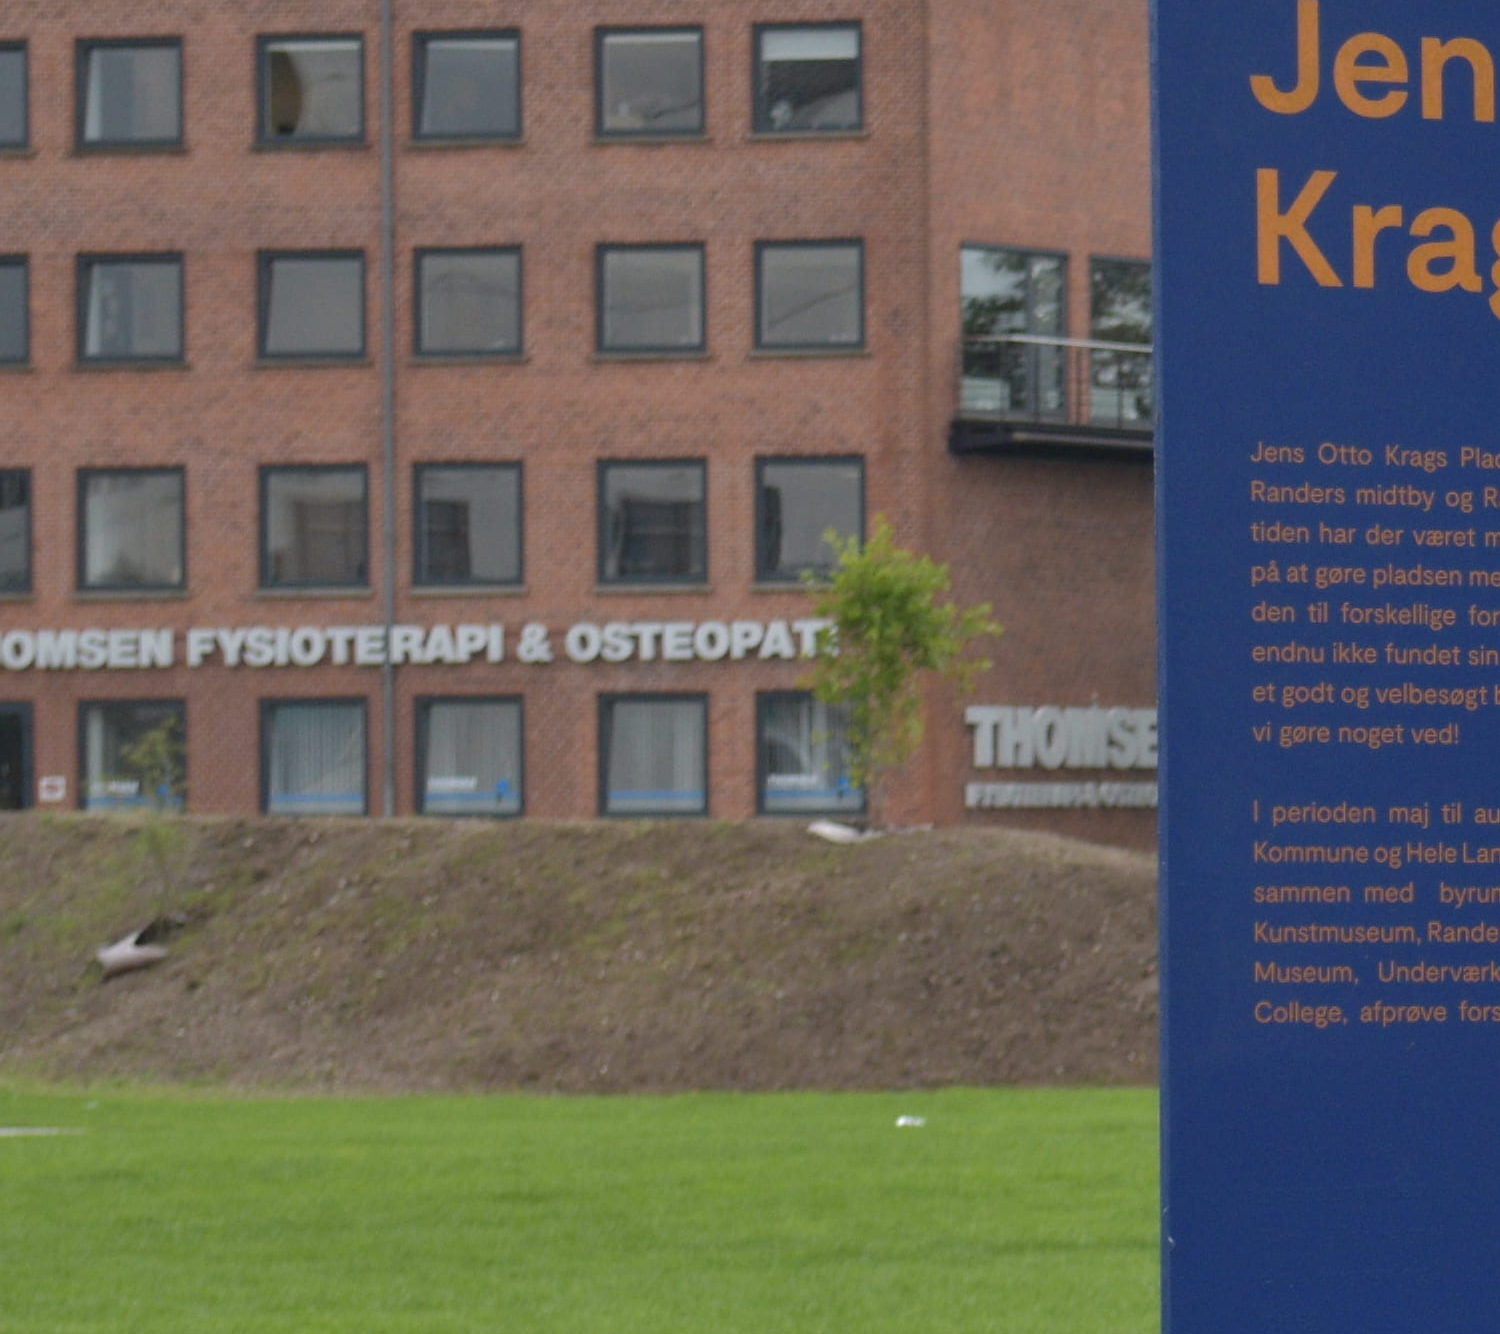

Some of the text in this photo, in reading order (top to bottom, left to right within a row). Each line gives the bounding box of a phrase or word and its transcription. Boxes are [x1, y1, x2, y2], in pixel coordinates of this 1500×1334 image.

[1251, 442, 1306, 464] Jens
[1318, 442, 1373, 465] Otto
[1385, 445, 1448, 473] Krags
[1251, 479, 1346, 504] Randers
[1356, 485, 1435, 511] midtby
[1445, 491, 1474, 513] og
[1251, 522, 1311, 543] tiden
[1319, 523, 1356, 544] har
[1366, 524, 1404, 545] der
[1413, 528, 1476, 547] været
[1251, 560, 1281, 586] på
[1286, 564, 1309, 583] at
[1315, 566, 1367, 589] gøre
[1373, 564, 1464, 589] pladsen
[1251, 601, 1296, 622] den
[1308, 602, 1330, 623] til
[1341, 602, 1457, 631] forskellige
[186, 622, 506, 668] FYSIOTERAPI
[517, 622, 553, 663] &
[1252, 642, 1326, 664] endnu
[1333, 642, 1378, 664] ikke
[1386, 642, 1461, 665] fundet
[1469, 647, 1500, 666] sin
[1253, 723, 1460, 749] vi gøre noget ved!
[1272, 802, 1377, 827] perioden
[1389, 805, 1430, 828] maj
[1442, 803, 1463, 823] til
[1254, 886, 1352, 903] sammen
[1364, 883, 1415, 903] med
[1254, 922, 1422, 944] Kunstmuseum,
[1254, 962, 1359, 983] Museum,
[1254, 1000, 1348, 1029] College,
[1360, 1001, 1448, 1026] afprøve
